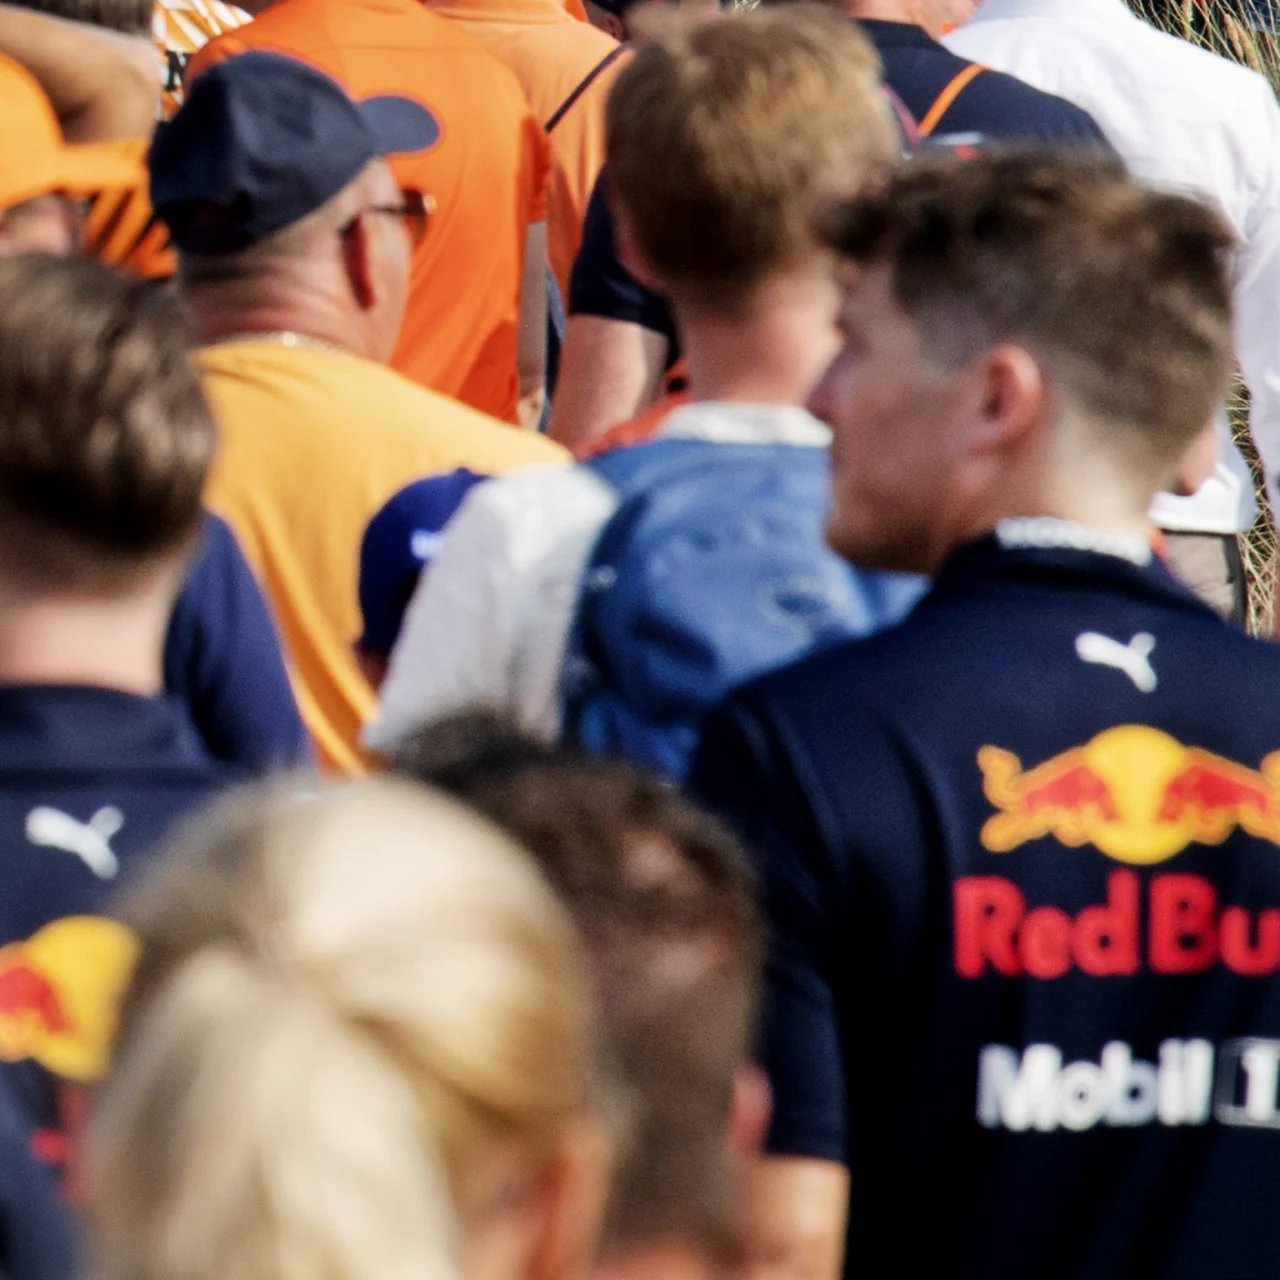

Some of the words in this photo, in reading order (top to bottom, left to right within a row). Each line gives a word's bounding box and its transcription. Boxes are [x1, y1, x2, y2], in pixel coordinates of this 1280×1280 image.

[954, 868, 1139, 980] Red
[1149, 874, 1280, 976] Bu
[977, 1037, 1214, 1133] Mobil
